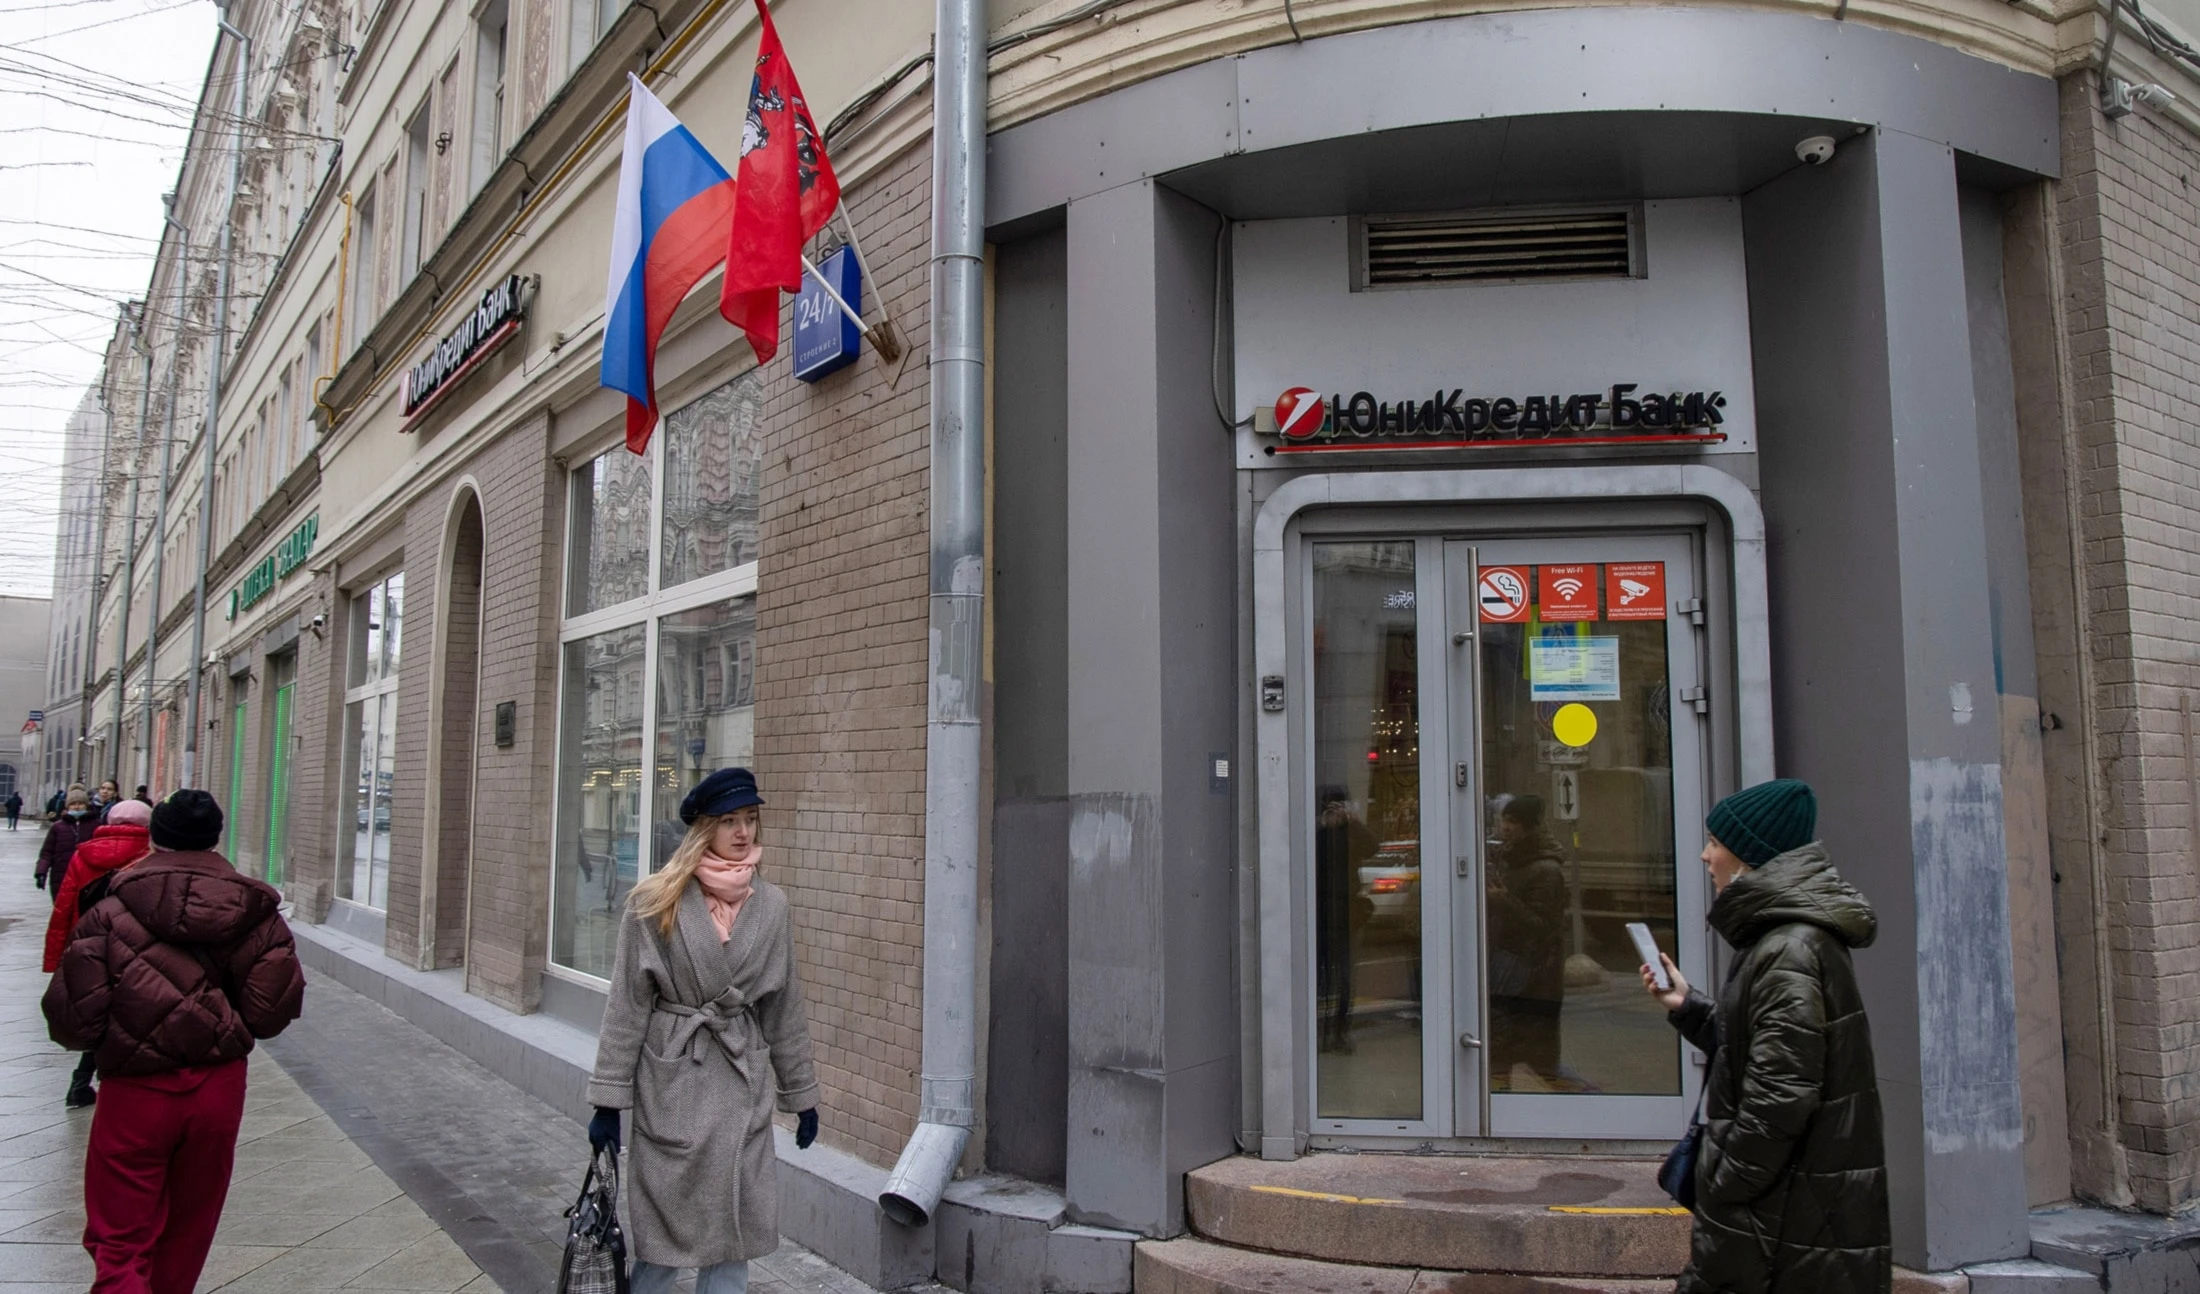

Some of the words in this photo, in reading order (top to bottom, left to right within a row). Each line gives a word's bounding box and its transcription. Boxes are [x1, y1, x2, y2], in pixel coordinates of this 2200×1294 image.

[408, 311, 477, 406] ЮниКредит
[477, 274, 516, 339] Банк
[799, 340, 831, 363] СТРОЕНИЕ
[1332, 388, 1602, 440] ЮниКредит
[1609, 383, 1726, 428] Банк
[1566, 566, 1584, 574] Wi-Fi
